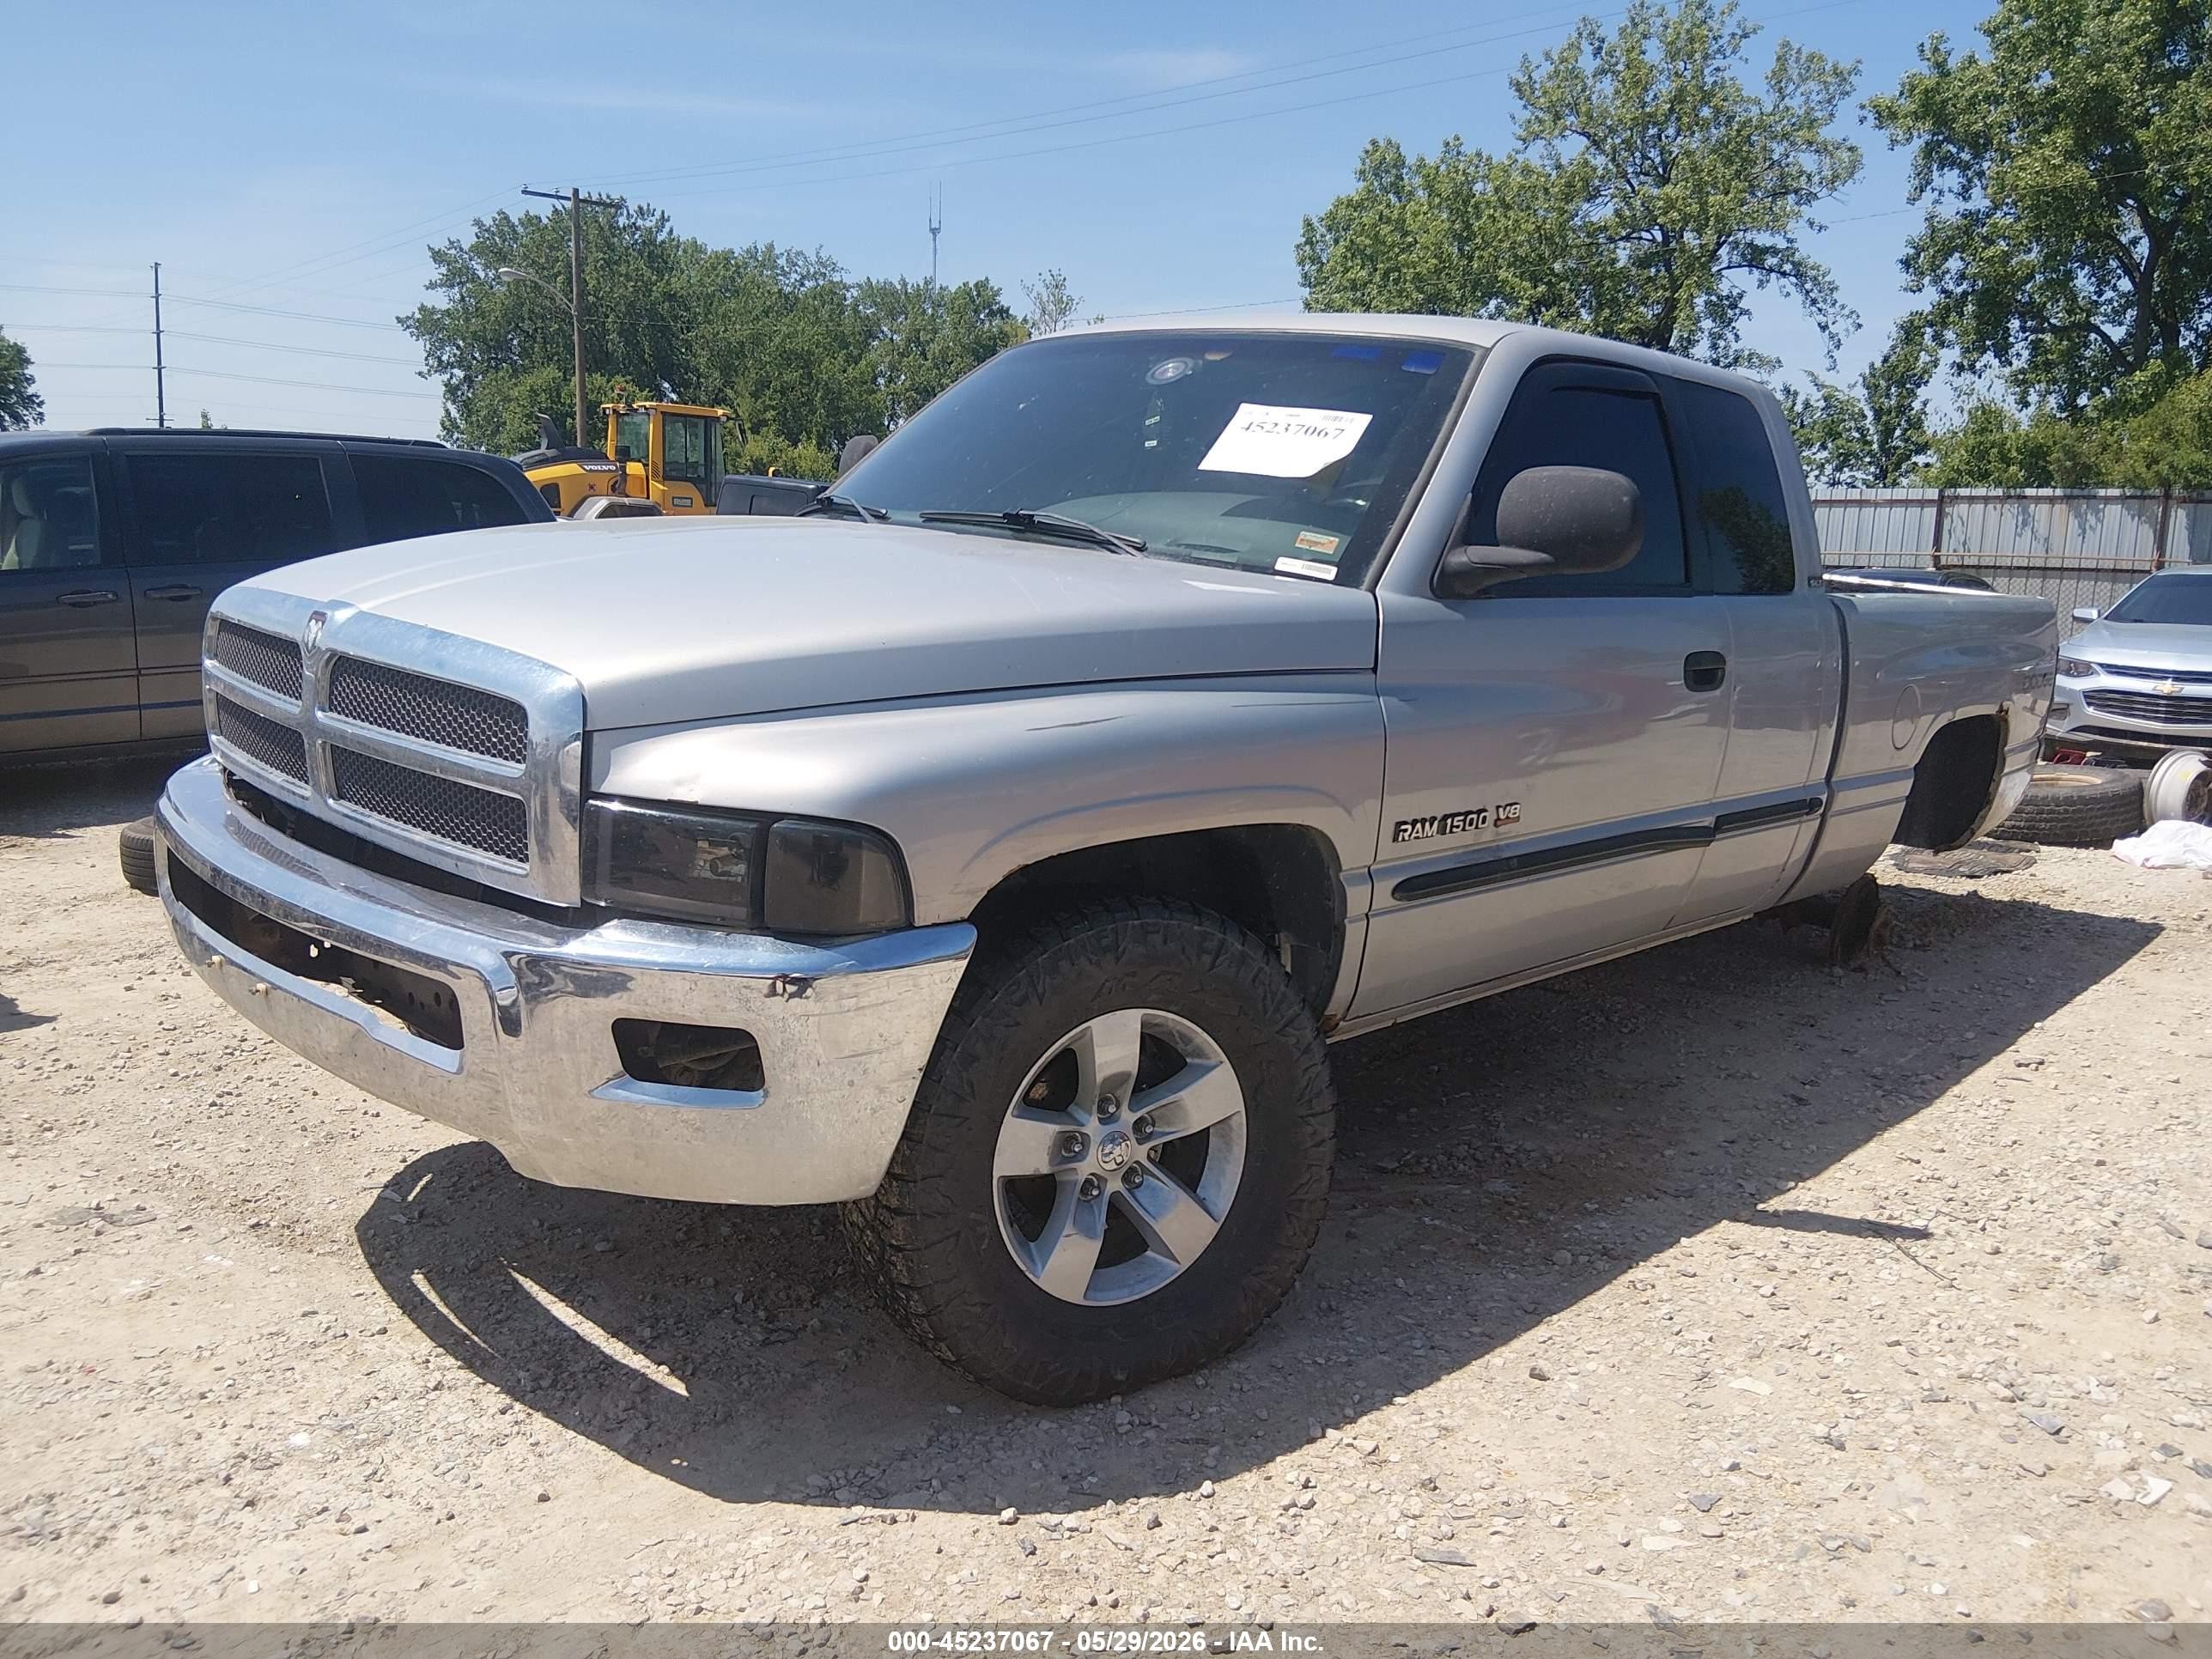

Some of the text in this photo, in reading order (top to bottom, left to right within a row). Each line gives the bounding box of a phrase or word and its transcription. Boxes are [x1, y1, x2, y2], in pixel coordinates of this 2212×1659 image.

[1241, 421, 1346, 441] 45237067
[1395, 802, 1522, 842] RAM 1500 V8
